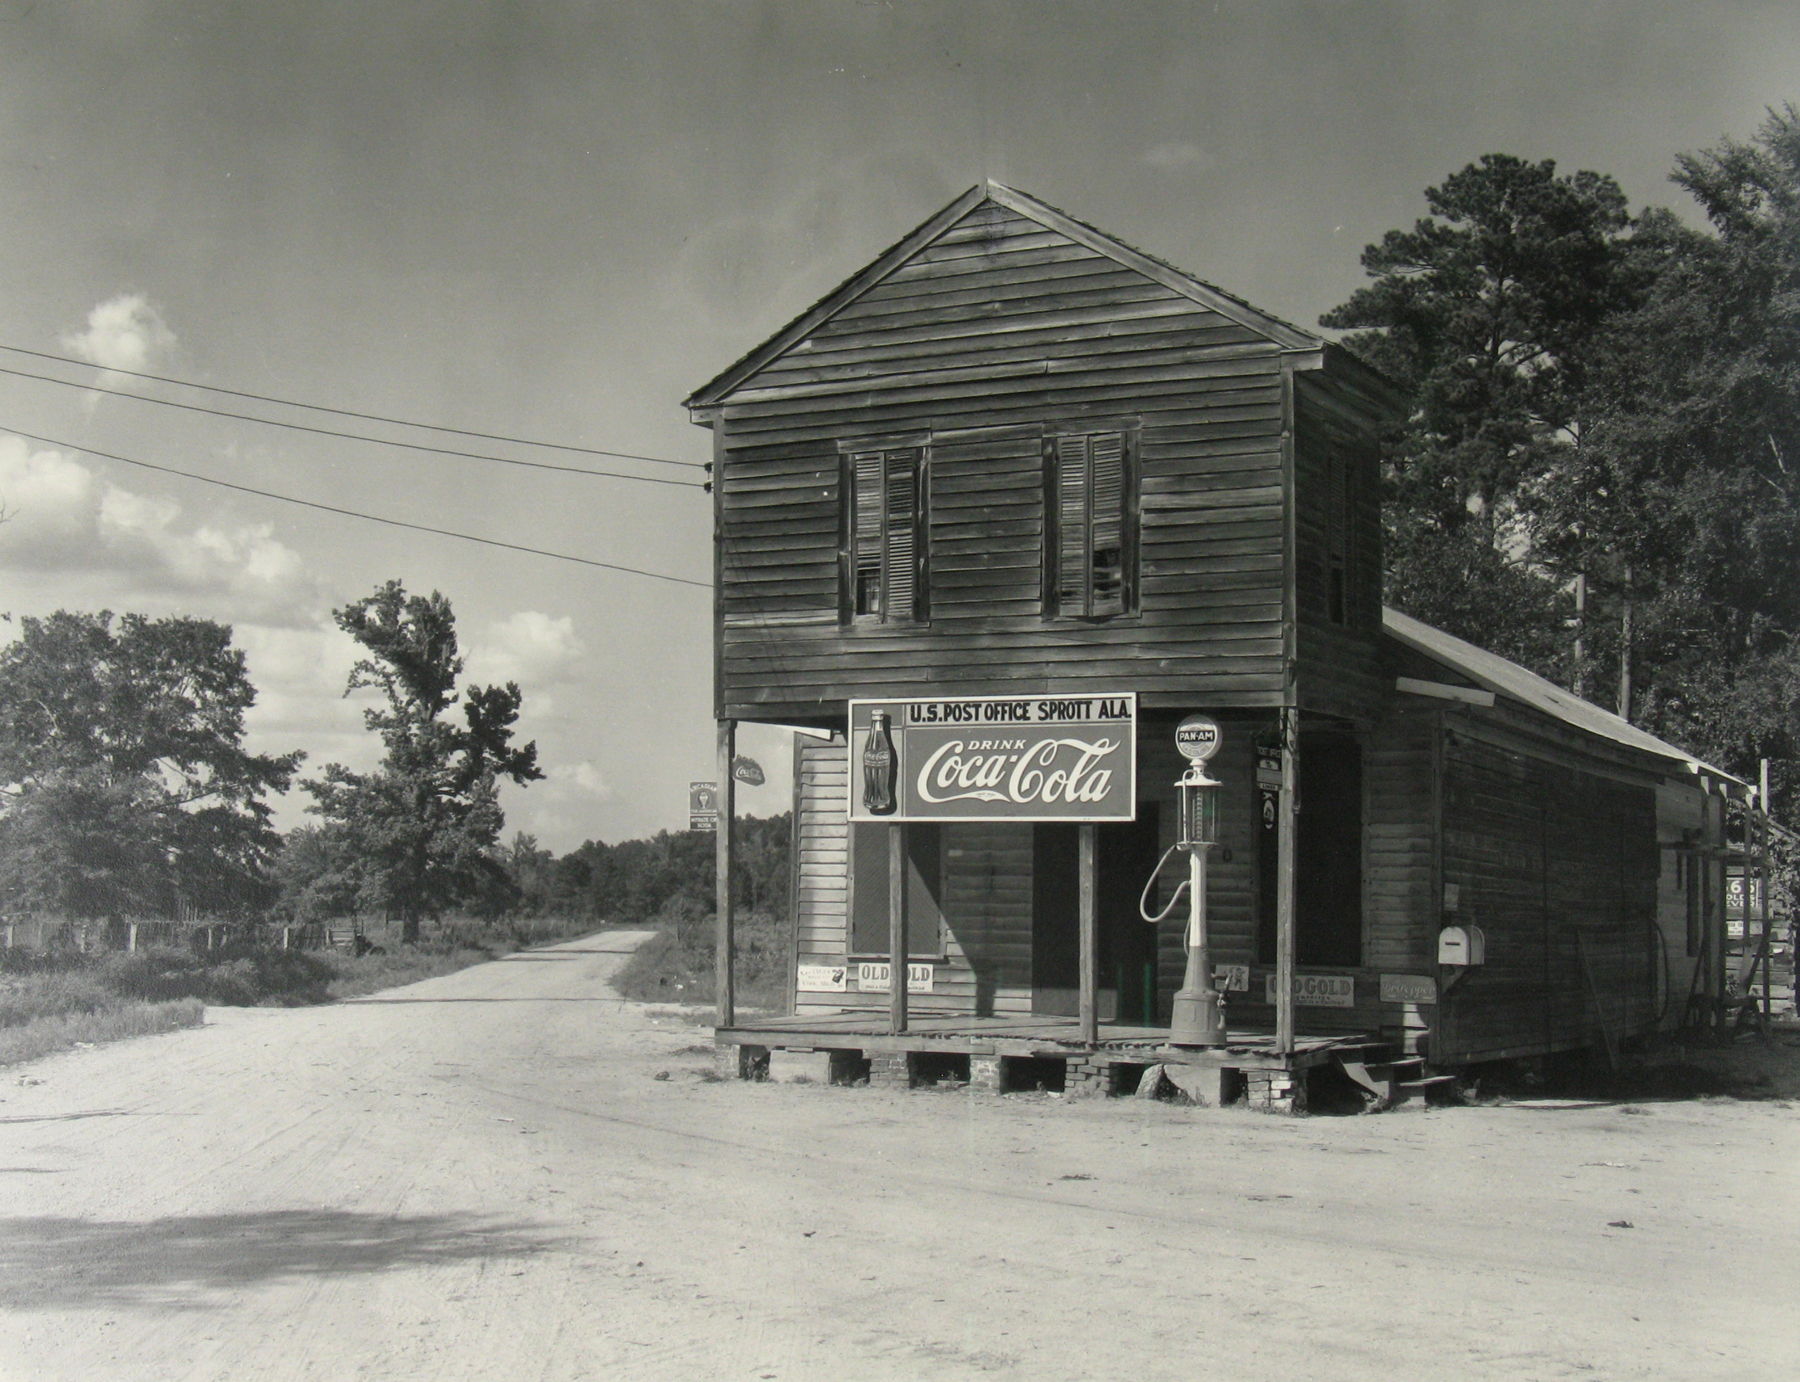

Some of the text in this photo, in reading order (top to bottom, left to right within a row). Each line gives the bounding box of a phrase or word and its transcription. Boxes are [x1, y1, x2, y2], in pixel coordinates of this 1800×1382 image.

[910, 699, 1132, 722] U.S. POST OFFICE SPROTT ALA.
[967, 739, 1027, 750] DRINK
[1180, 732, 1214, 740] PAN-AM
[917, 738, 1122, 803] Coca-Cola
[861, 964, 889, 980] OLD
[1304, 977, 1351, 996] GOLD
